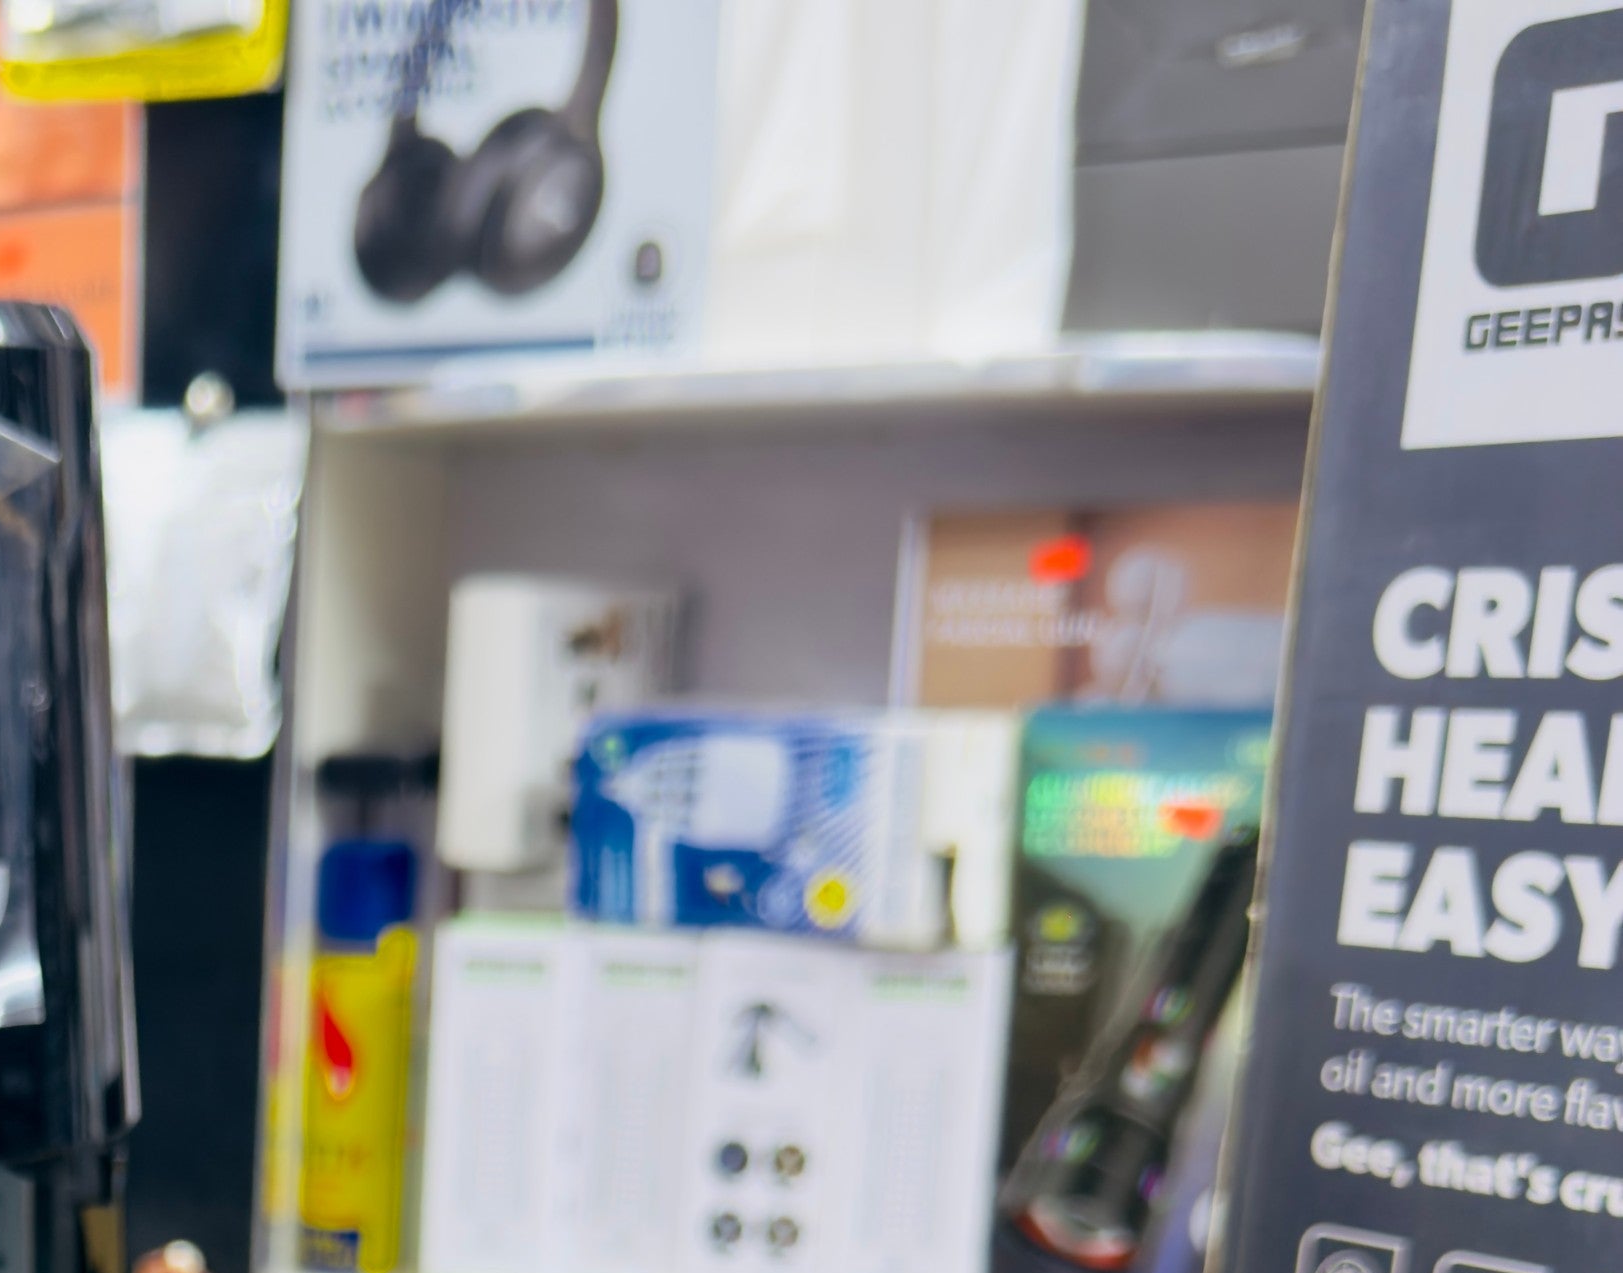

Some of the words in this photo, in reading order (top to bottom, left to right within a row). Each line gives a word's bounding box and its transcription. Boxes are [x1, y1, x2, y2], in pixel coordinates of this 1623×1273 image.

[1464, 299, 1623, 351] GEEPA
[1373, 563, 1623, 681] CRIS
[1336, 840, 1623, 970] EASY
[1330, 982, 1404, 1036] The
[1402, 1003, 1557, 1053] smarter
[1560, 1021, 1623, 1075] wa
[1320, 1048, 1375, 1095] oil
[1371, 1059, 1453, 1106] and
[1451, 1075, 1563, 1122] more
[1310, 1120, 1416, 1188] Gee,
